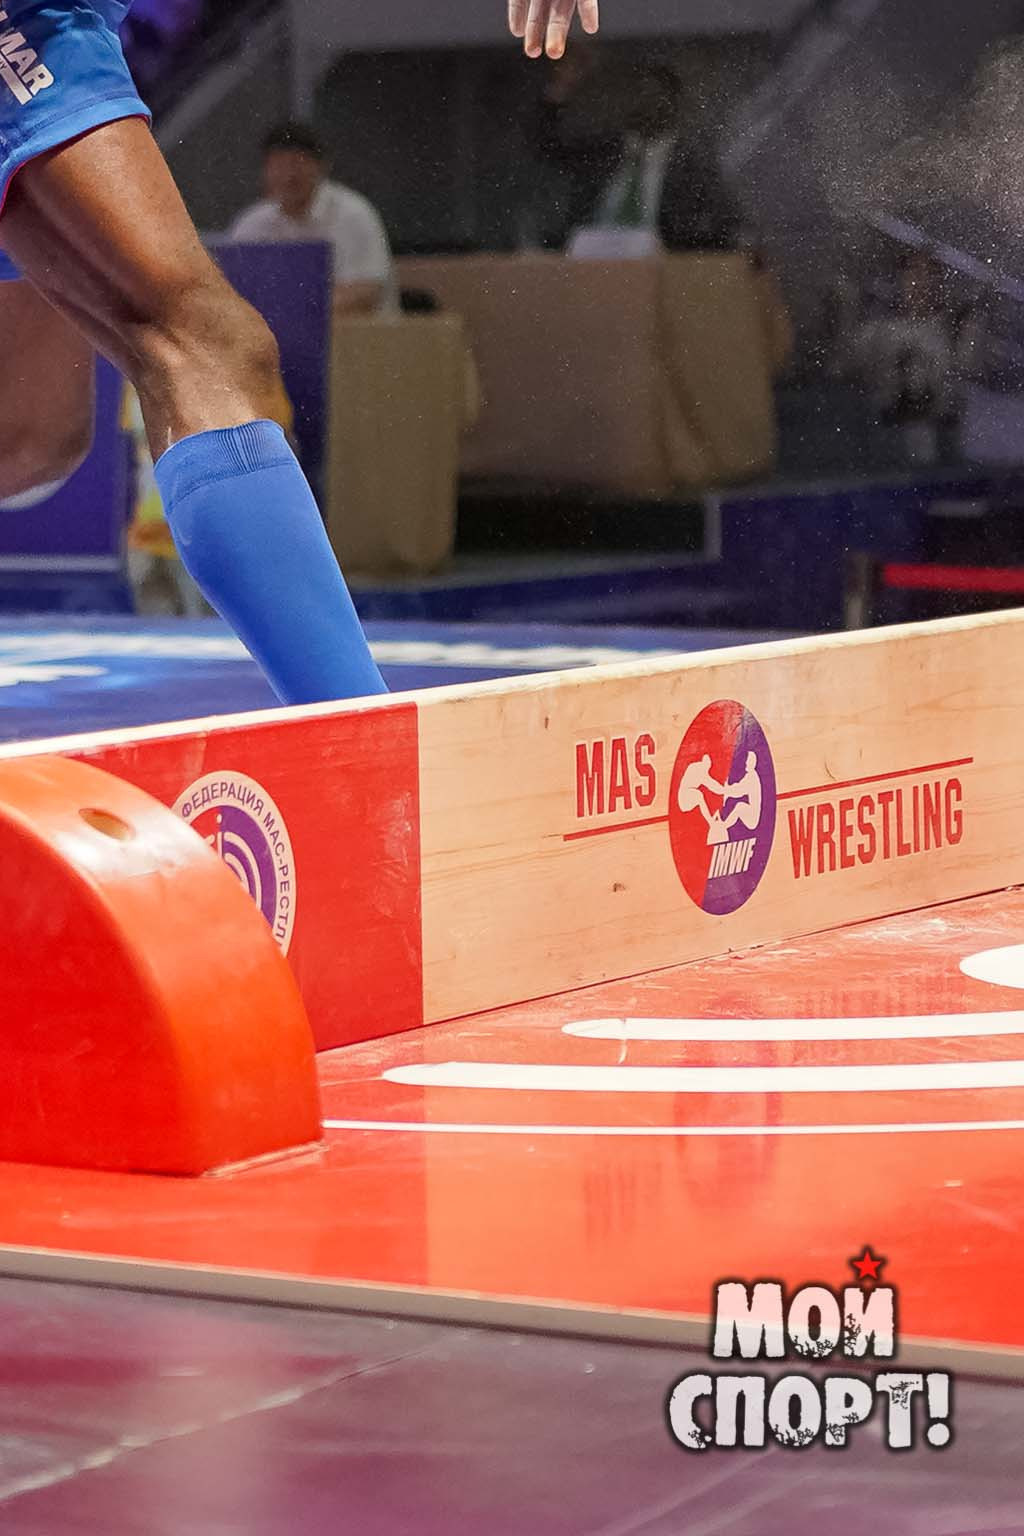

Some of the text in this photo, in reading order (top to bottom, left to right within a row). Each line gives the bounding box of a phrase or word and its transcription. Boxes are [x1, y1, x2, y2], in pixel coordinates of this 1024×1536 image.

[576, 734, 656, 818] MAS
[182, 781, 290, 947] ФЕДЕРАЦИЯ МАС-РЕСТЛ
[707, 838, 757, 879] IMWF
[787, 777, 963, 879] WRESTLING
